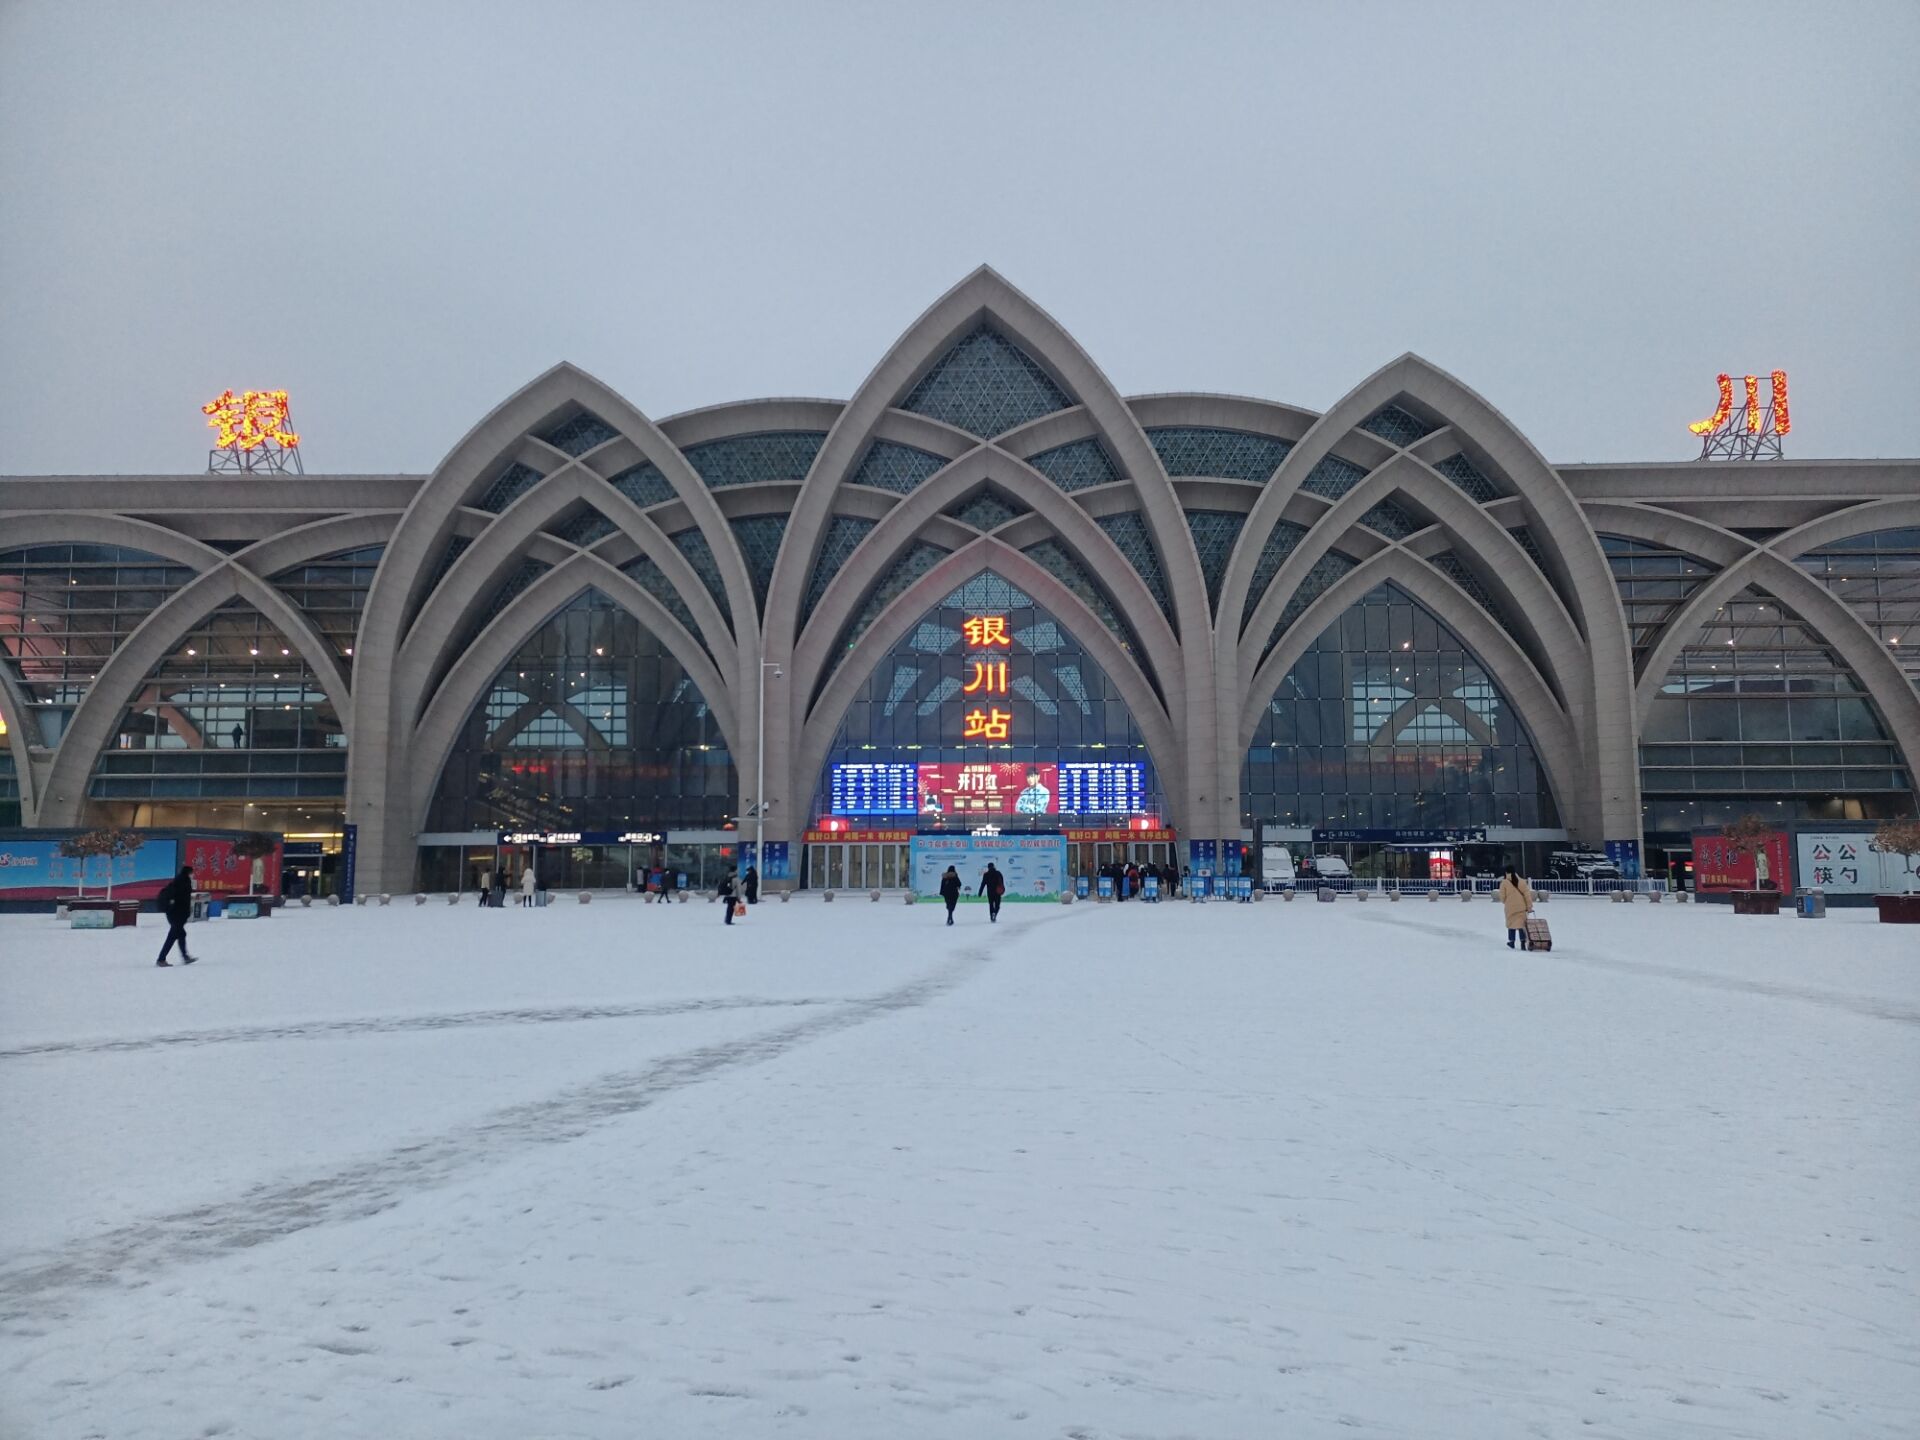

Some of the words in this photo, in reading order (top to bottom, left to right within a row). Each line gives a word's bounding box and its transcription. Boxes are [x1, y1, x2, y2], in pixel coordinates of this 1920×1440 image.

[202, 390, 299, 449] 银
[1688, 370, 1790, 435] 川
[963, 615, 1011, 739] 银川站
[958, 773, 998, 791] 开门红
